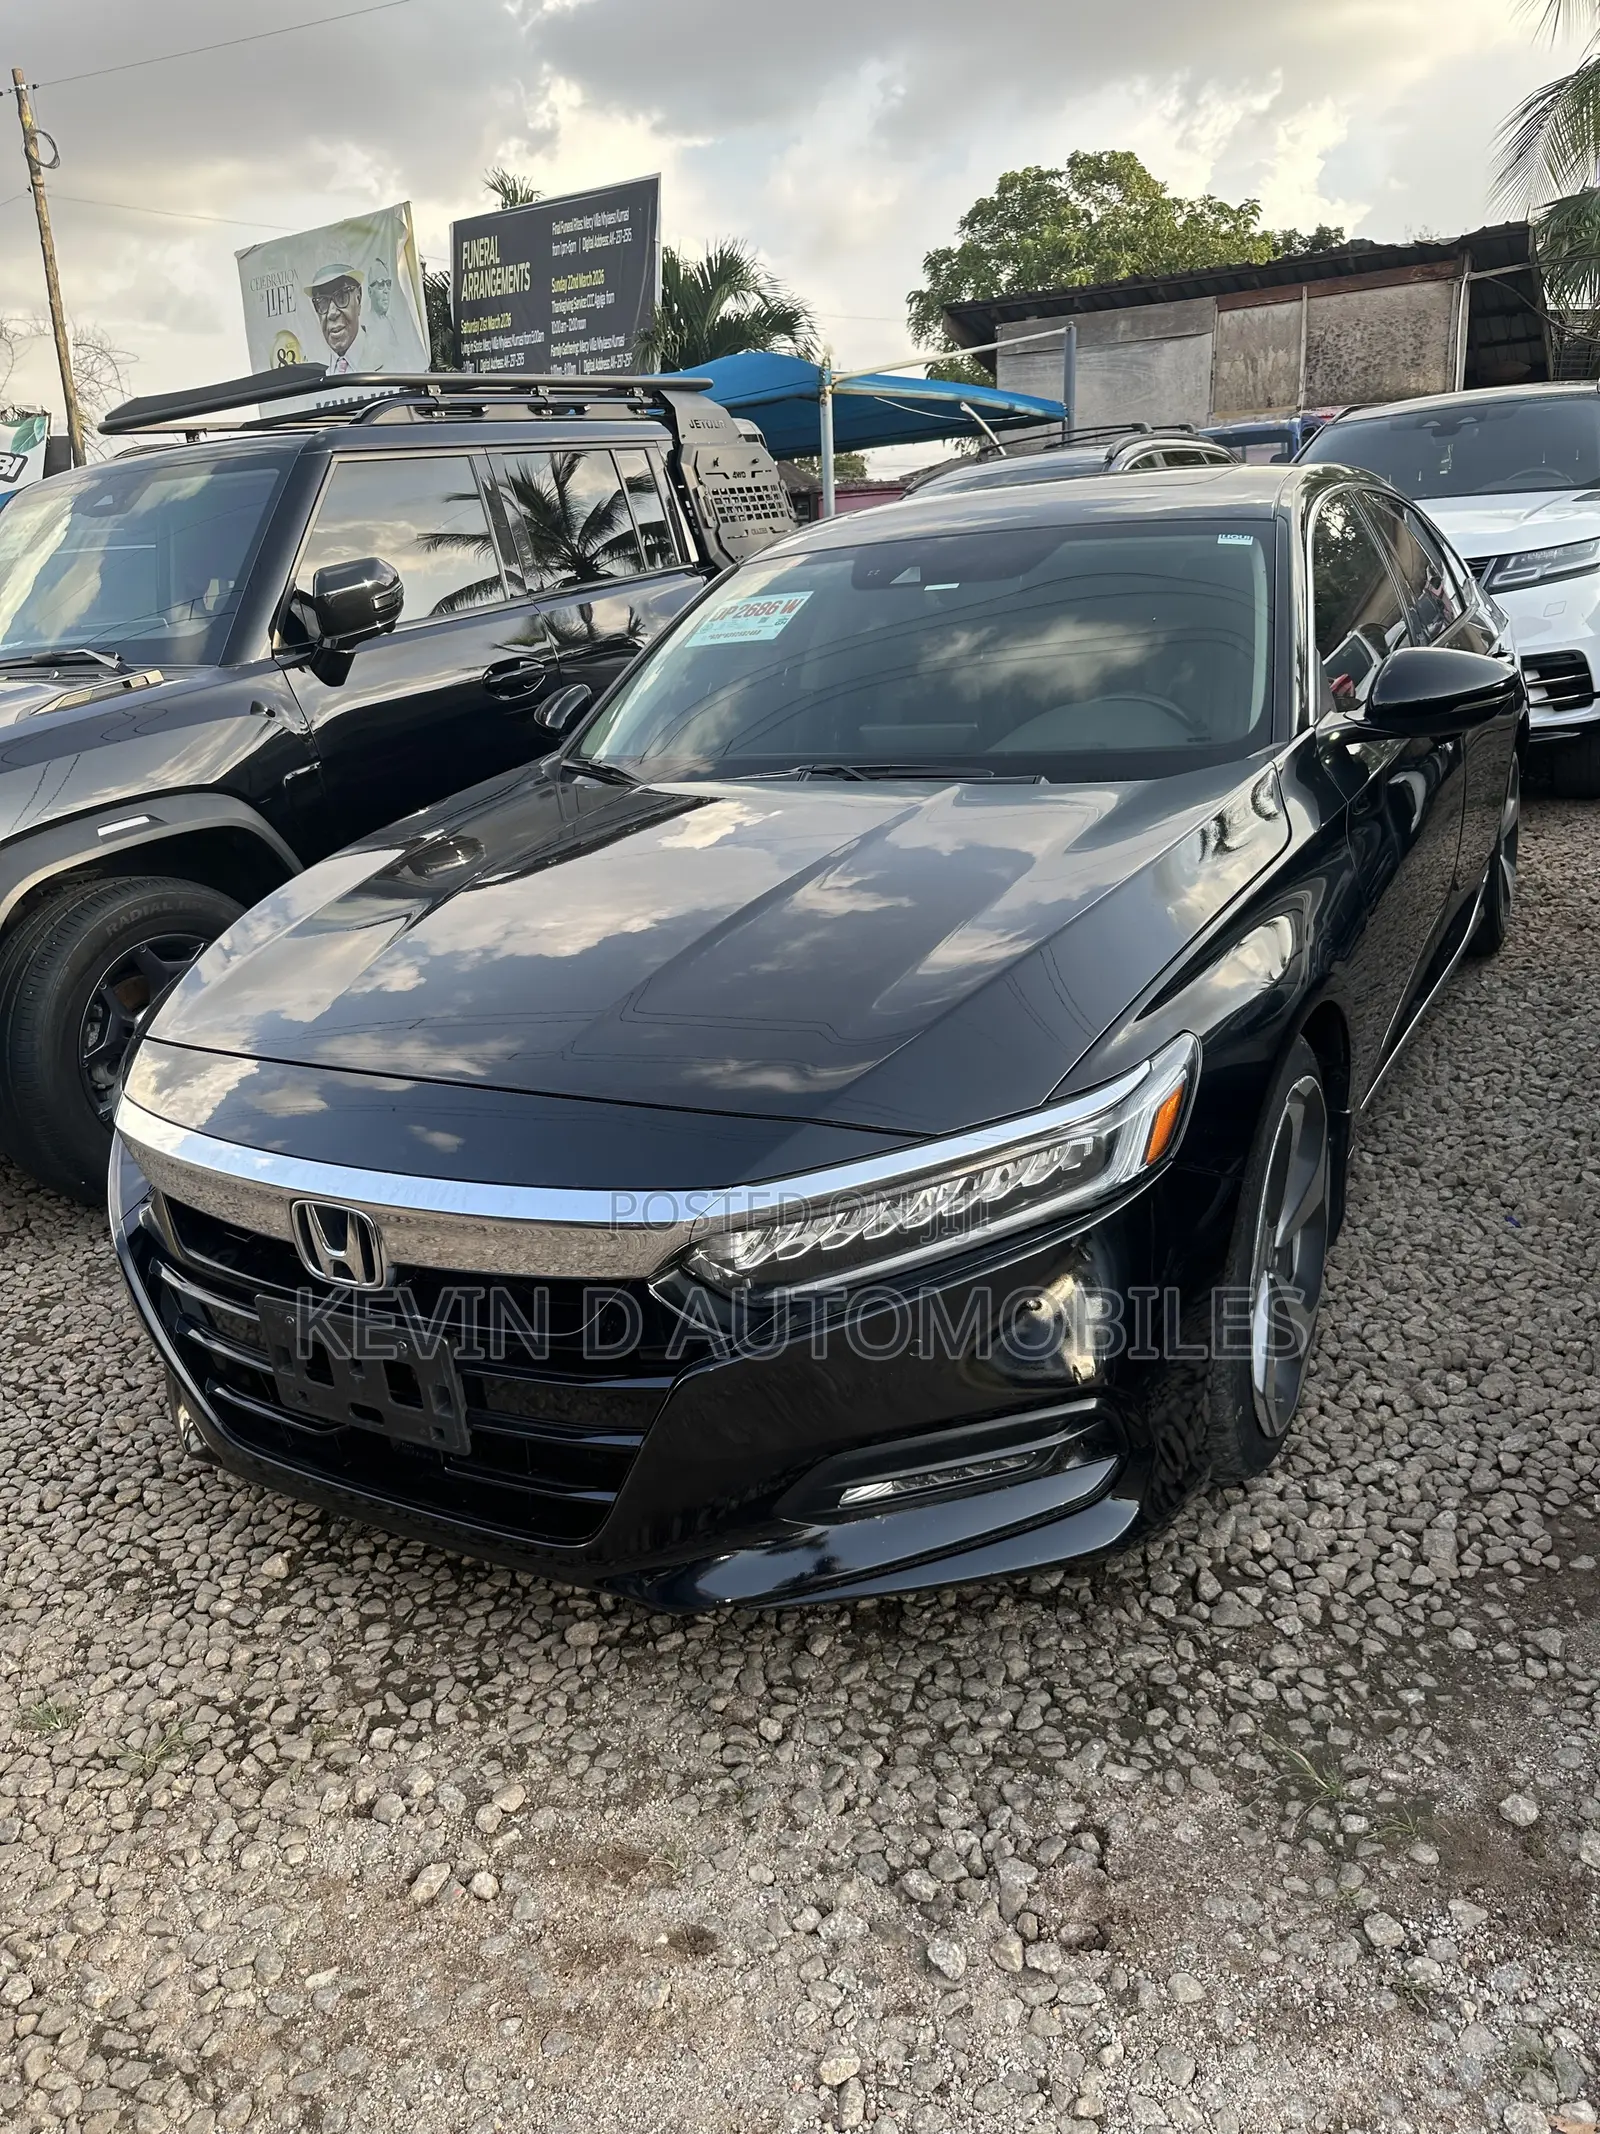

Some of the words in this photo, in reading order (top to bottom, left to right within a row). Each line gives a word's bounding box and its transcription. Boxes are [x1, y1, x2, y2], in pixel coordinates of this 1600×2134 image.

[462, 235, 500, 270] FUNERAL
[250, 268, 299, 291] CELEBRATION
[461, 261, 531, 301] ARRANGEMENTS
[578, 271, 592, 288] March
[266, 284, 296, 318] LIFE
[461, 317, 480, 335] Saturday
[488, 314, 500, 330] March
[689, 419, 727, 429] JETOUR
[732, 600, 783, 619] 2686
[780, 598, 805, 614] W
[106, 900, 174, 936] RADIAL
